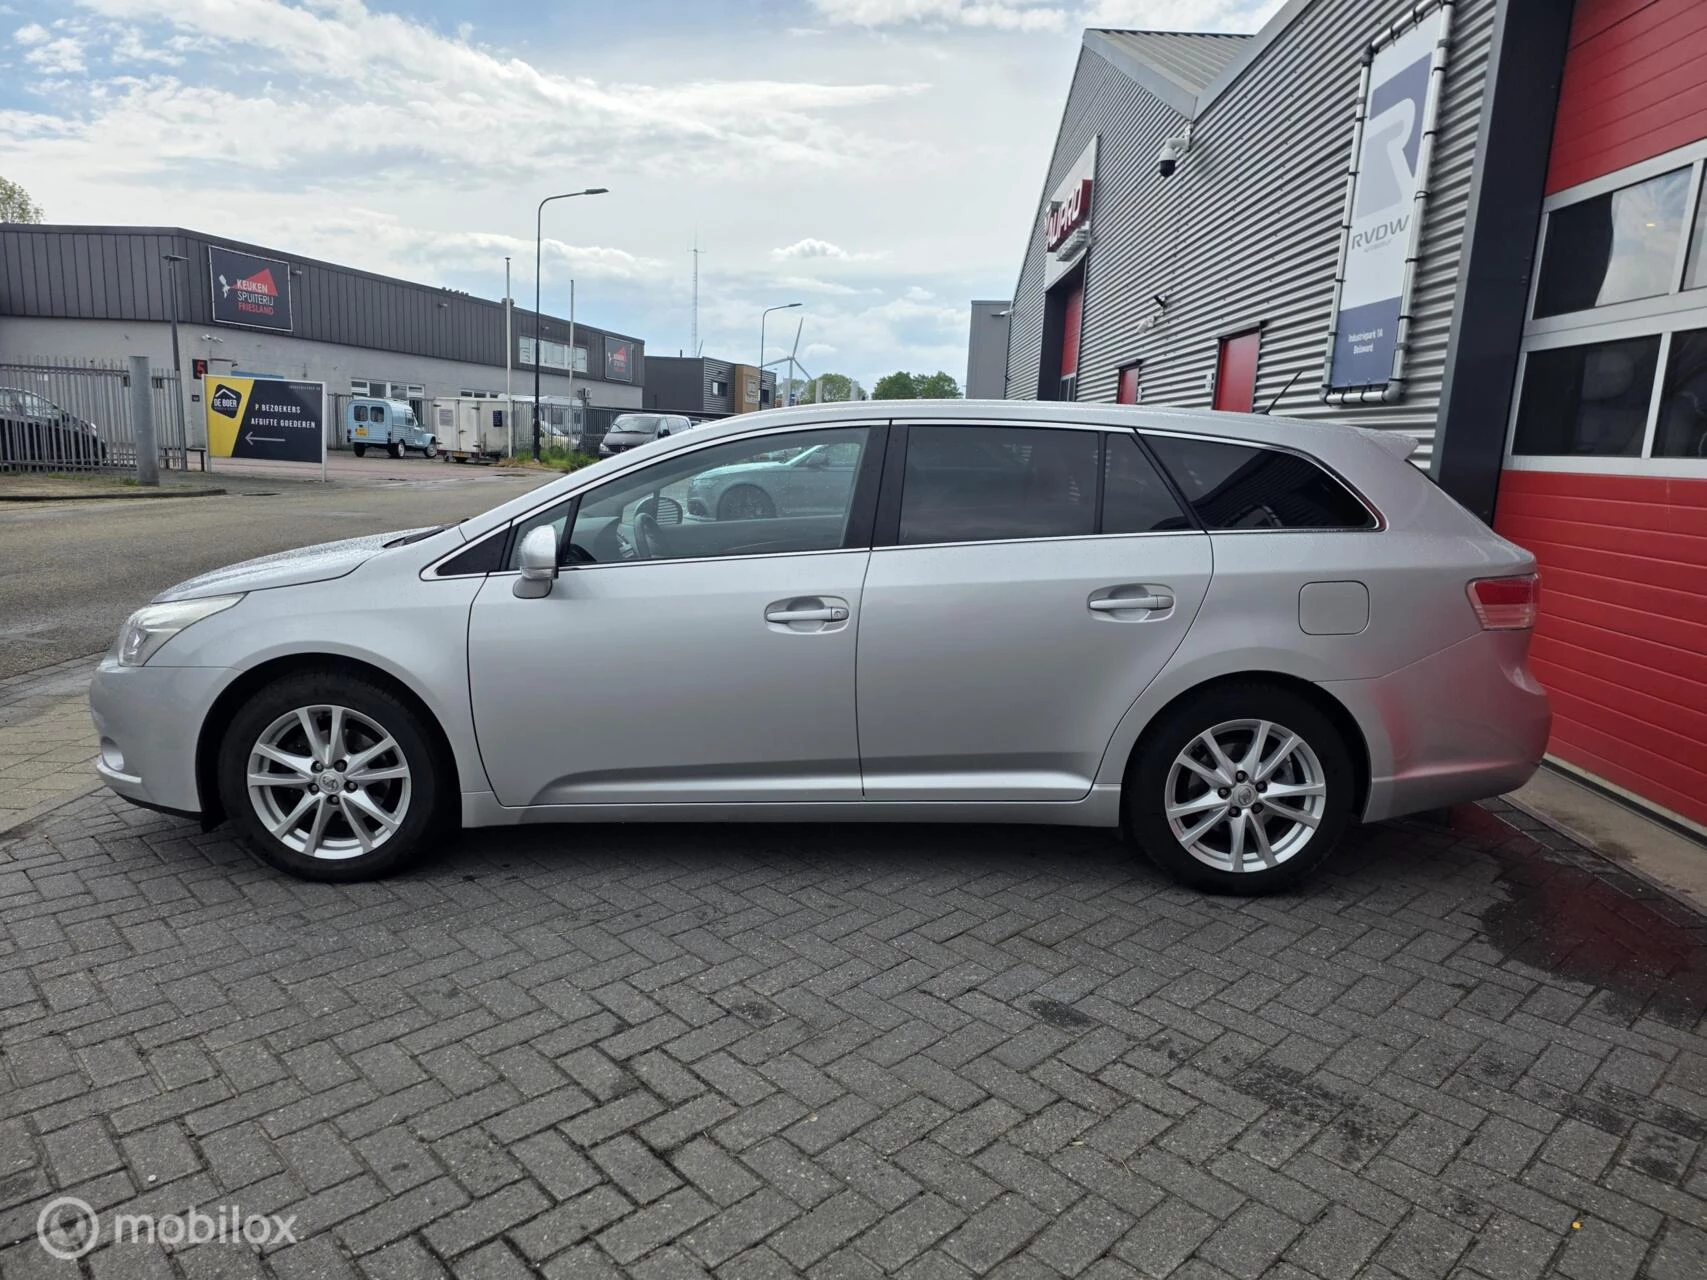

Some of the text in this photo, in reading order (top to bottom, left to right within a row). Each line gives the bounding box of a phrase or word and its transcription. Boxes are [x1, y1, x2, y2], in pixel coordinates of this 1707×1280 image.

[1352, 214, 1410, 250] RVDW
[237, 279, 268, 294] KEUKEN
[237, 291, 274, 306] SPUITERIJ
[238, 302, 274, 316] FRIESLAND
[213, 398, 238, 408] DE BOER
[255, 403, 301, 414] P BEZOEKERS
[250, 418, 316, 429] AFGIFTE GOEDEREN
